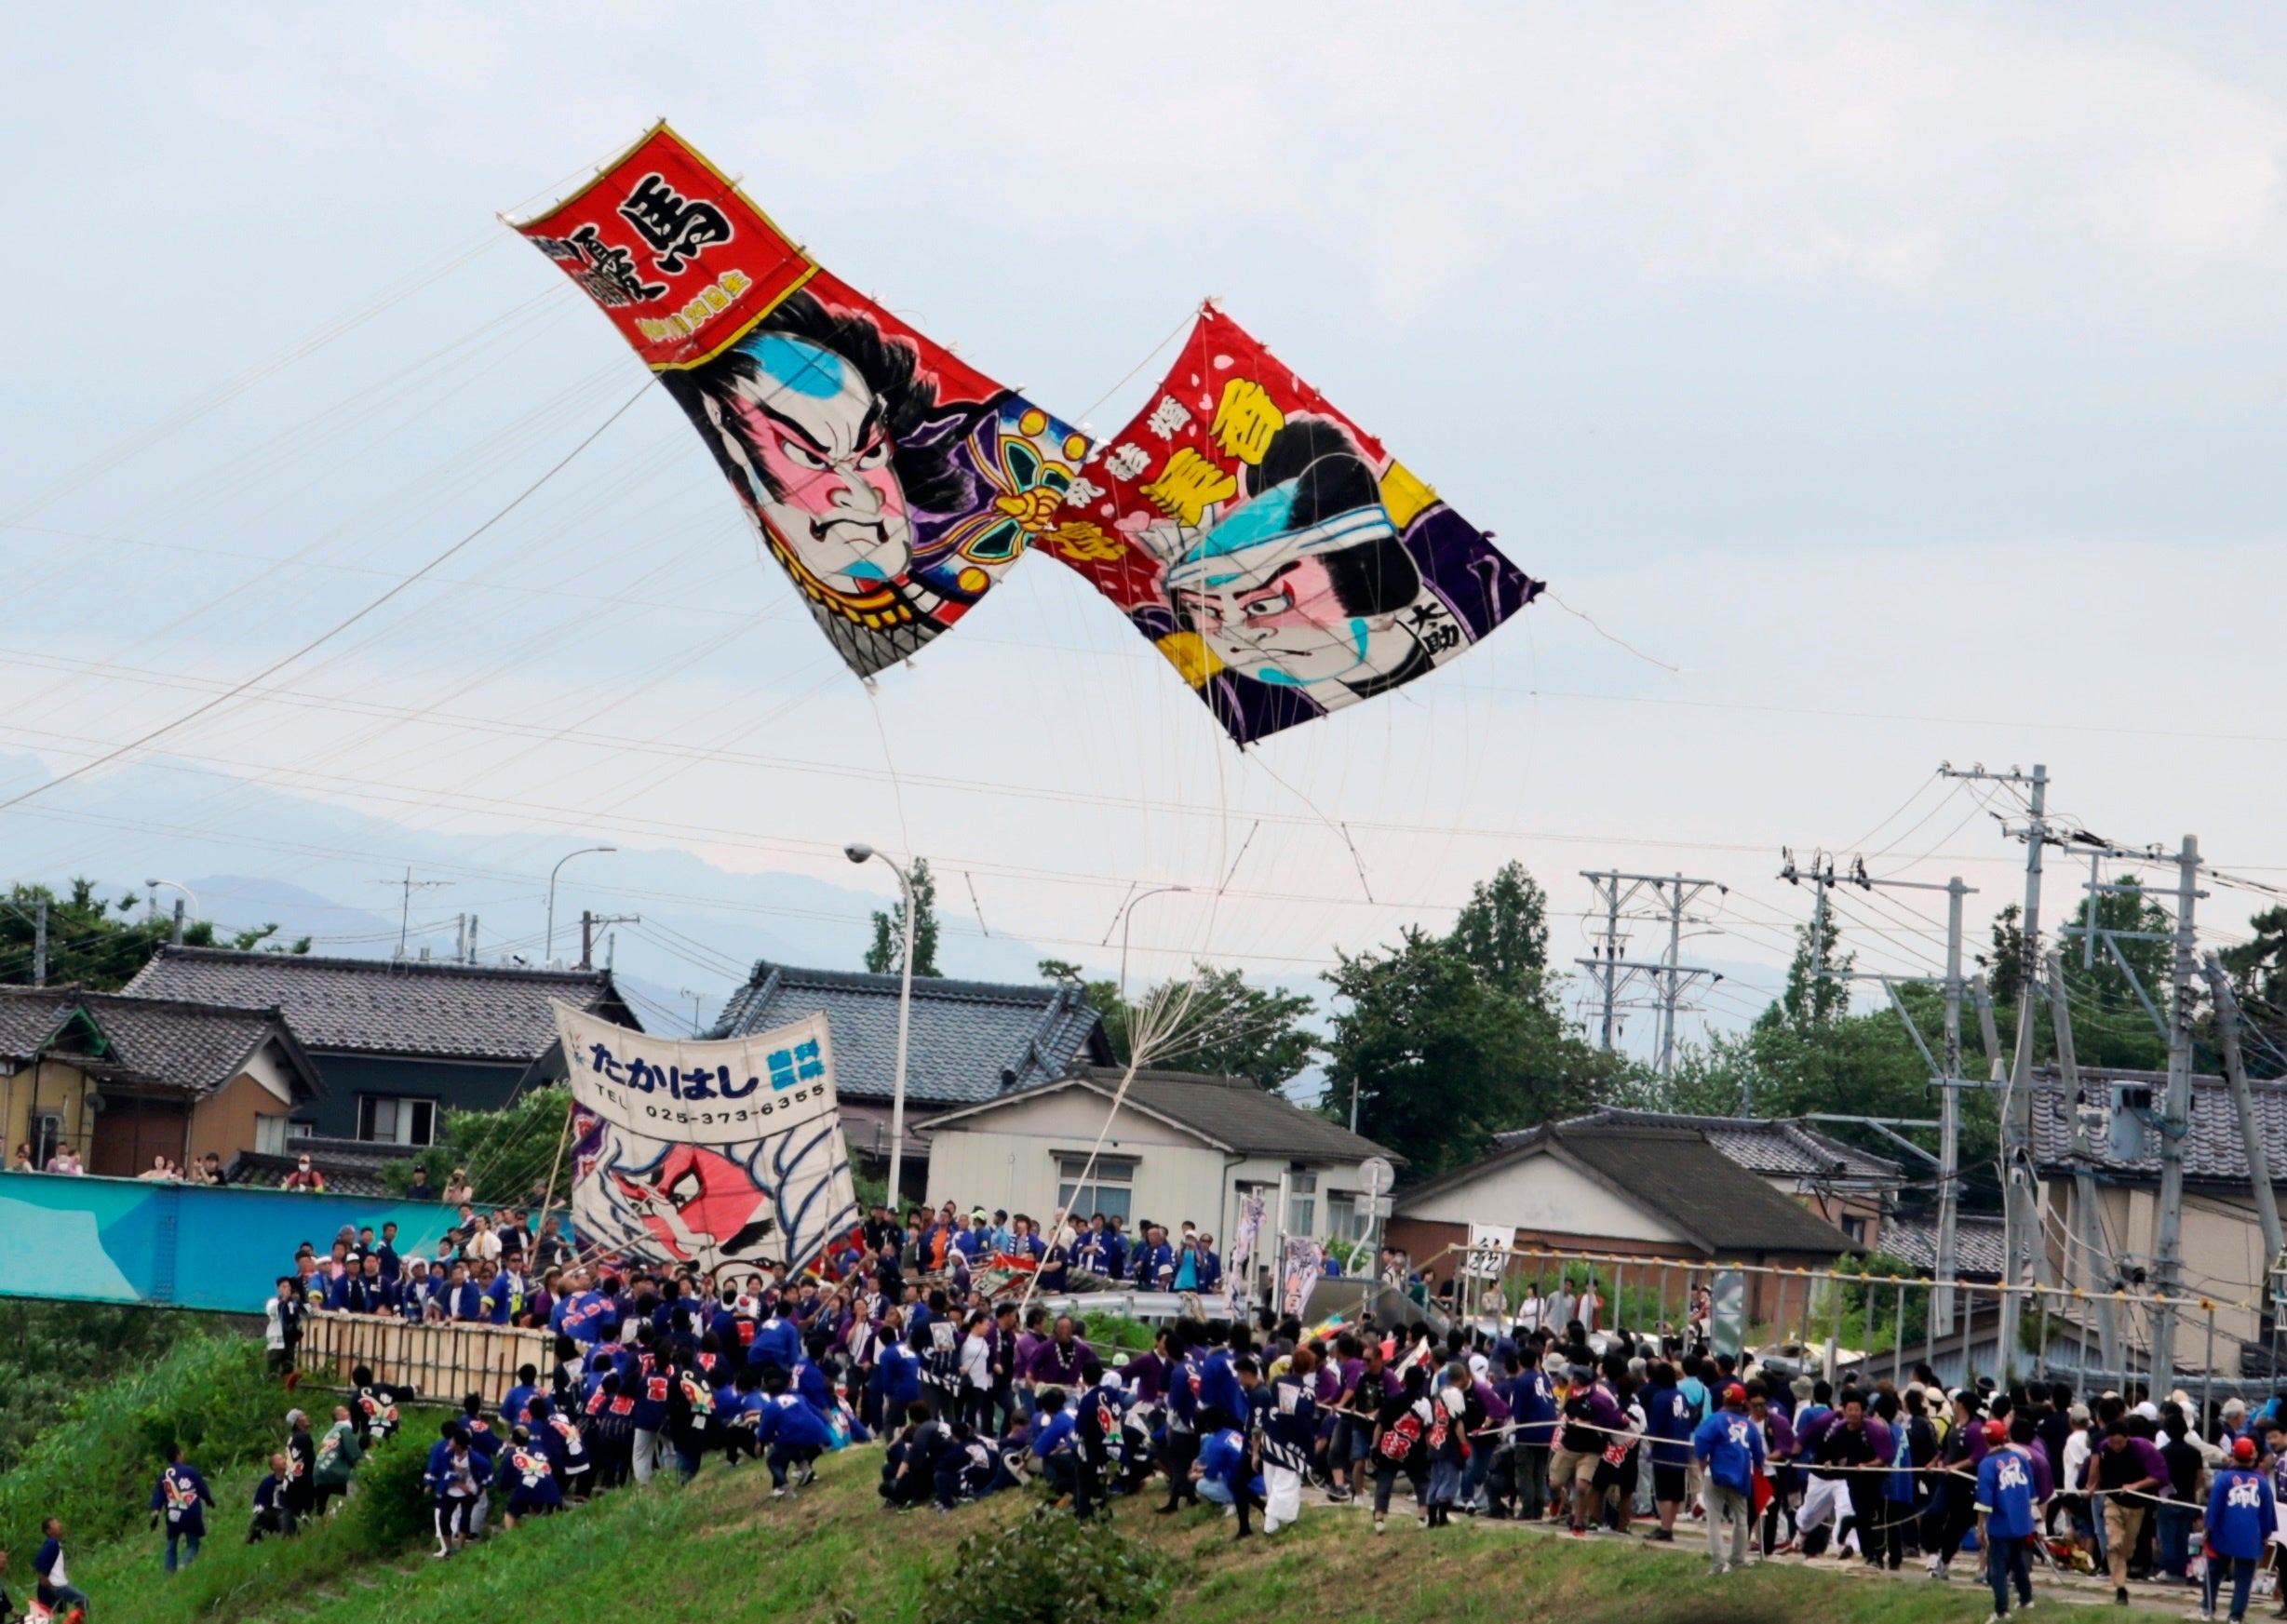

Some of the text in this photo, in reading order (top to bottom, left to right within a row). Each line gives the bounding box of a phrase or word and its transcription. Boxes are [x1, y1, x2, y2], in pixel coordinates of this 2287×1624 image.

[589, 1042, 760, 1101] たかはし
[595, 1082, 825, 1124] TEL 025-373-6355
